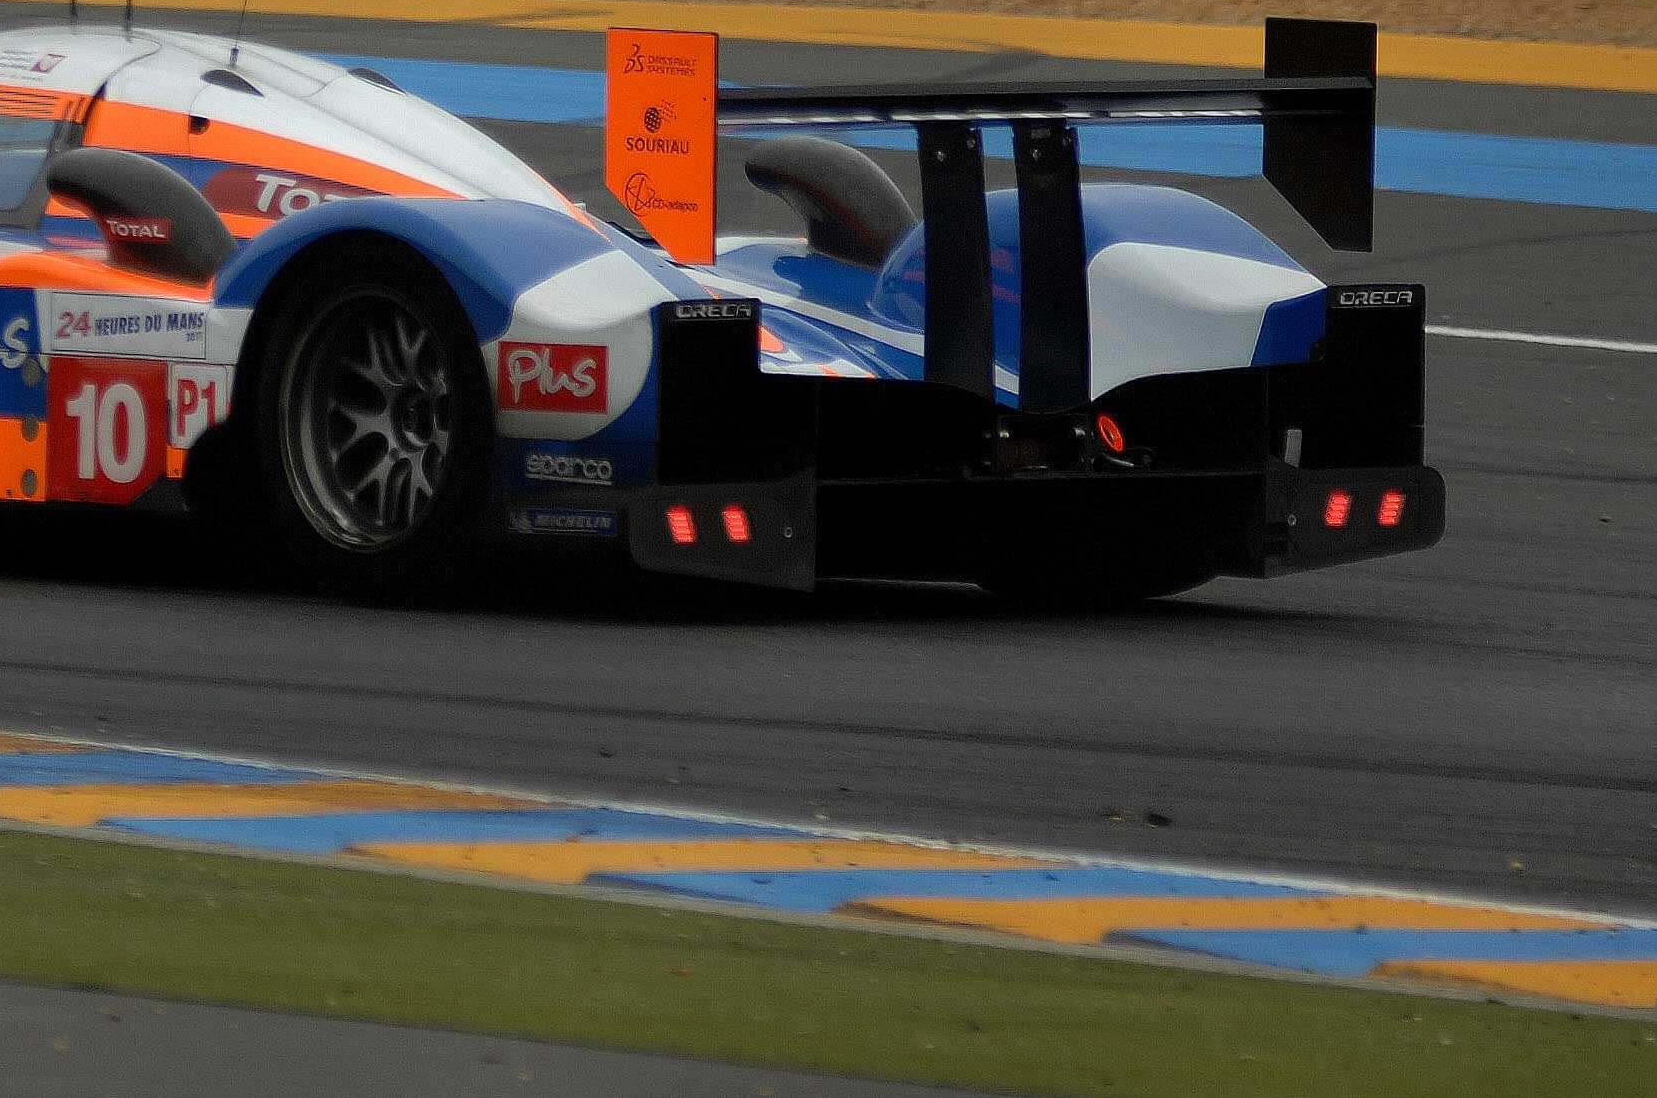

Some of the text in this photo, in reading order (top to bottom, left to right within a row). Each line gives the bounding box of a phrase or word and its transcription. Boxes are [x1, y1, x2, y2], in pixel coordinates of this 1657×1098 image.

[626, 137, 689, 154] SOURIAU
[256, 173, 348, 217] TO
[106, 219, 166, 239] TOTAL
[1340, 290, 1413, 305] ORECA
[676, 304, 752, 318] ORECA
[56, 310, 204, 338] 24 HEURES DU MANS
[509, 348, 597, 404] Plus
[177, 379, 215, 436] P1
[66, 383, 146, 484] 10
[526, 454, 613, 476] sparco
